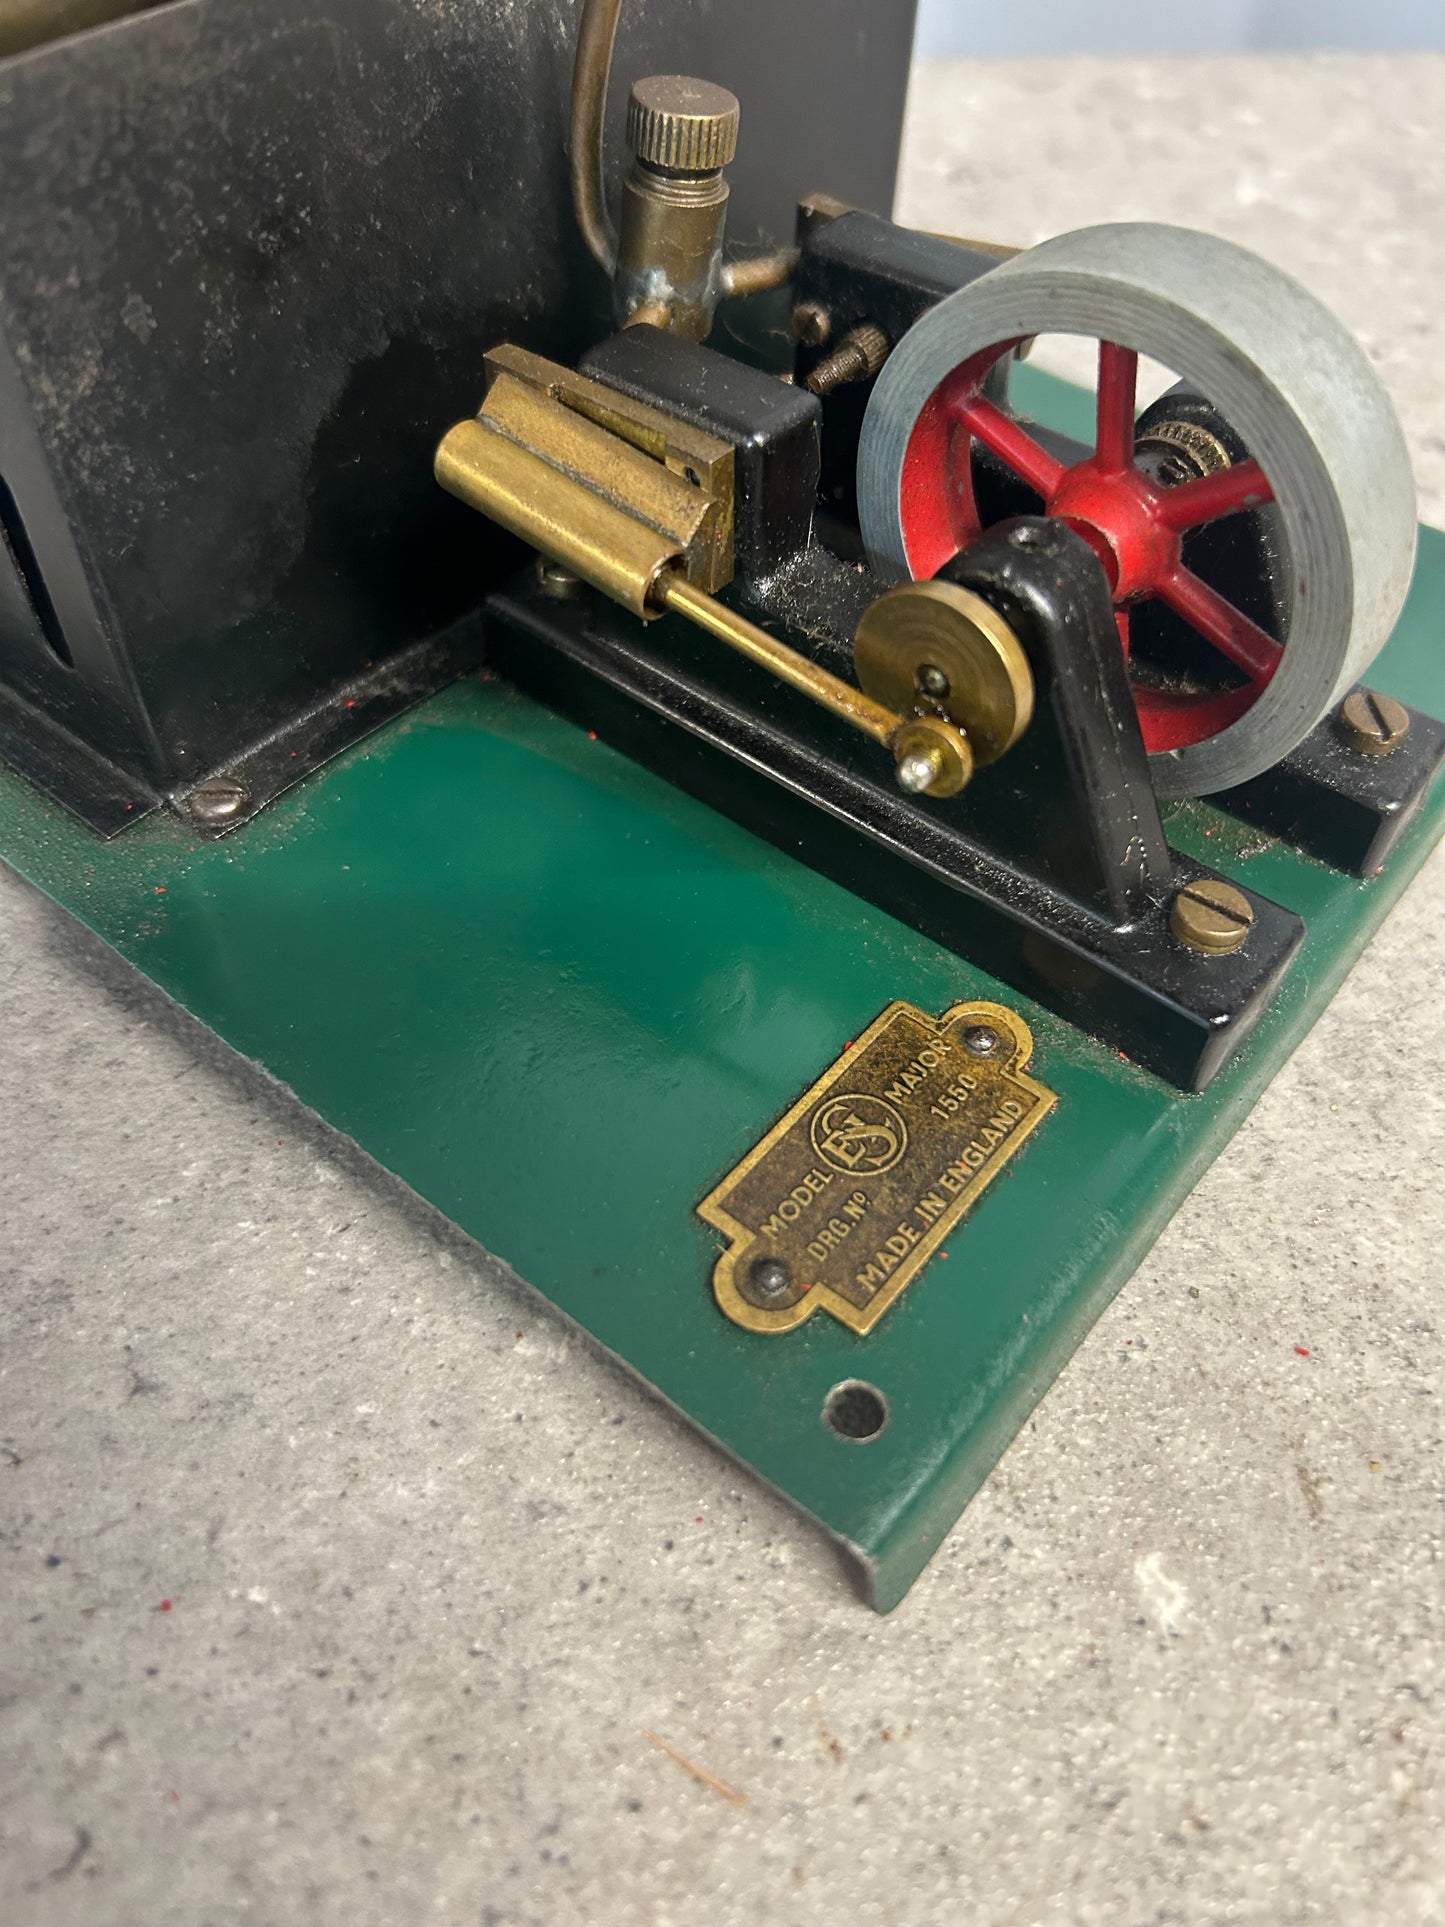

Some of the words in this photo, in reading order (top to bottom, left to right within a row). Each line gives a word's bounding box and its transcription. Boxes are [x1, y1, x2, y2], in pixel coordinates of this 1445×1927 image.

[759, 1168, 834, 1240] MODEL
[884, 1037, 951, 1106] MAJOR
[929, 1073, 977, 1120] 1550
[856, 1220, 921, 1291] MADE
[914, 1190, 946, 1223] IN
[941, 1099, 1024, 1195] ENGLAND
